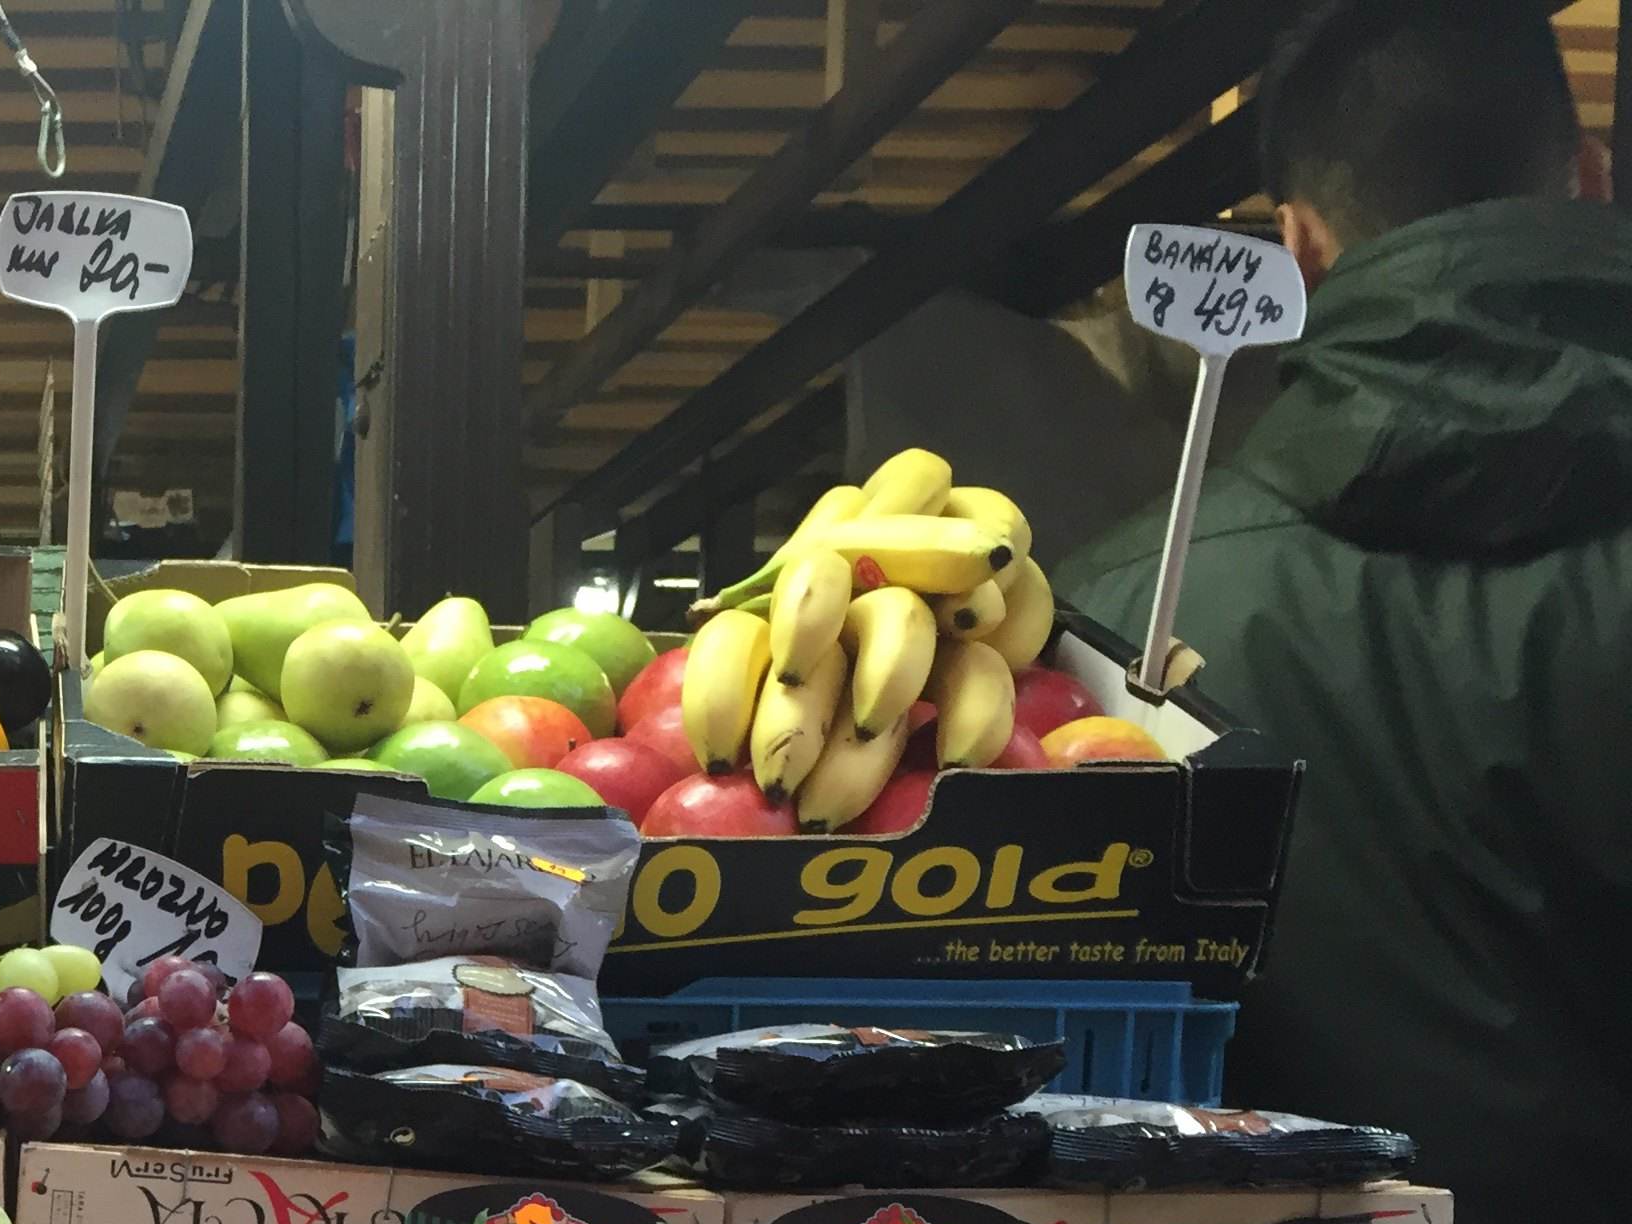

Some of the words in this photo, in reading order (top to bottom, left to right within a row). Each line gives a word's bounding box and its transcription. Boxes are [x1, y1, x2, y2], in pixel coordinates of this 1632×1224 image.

[793, 842, 1131, 926] gold
[989, 938, 1060, 962] better
[1070, 938, 1125, 963] taste
[1135, 938, 1186, 963] from
[1195, 938, 1251, 968] Italy
